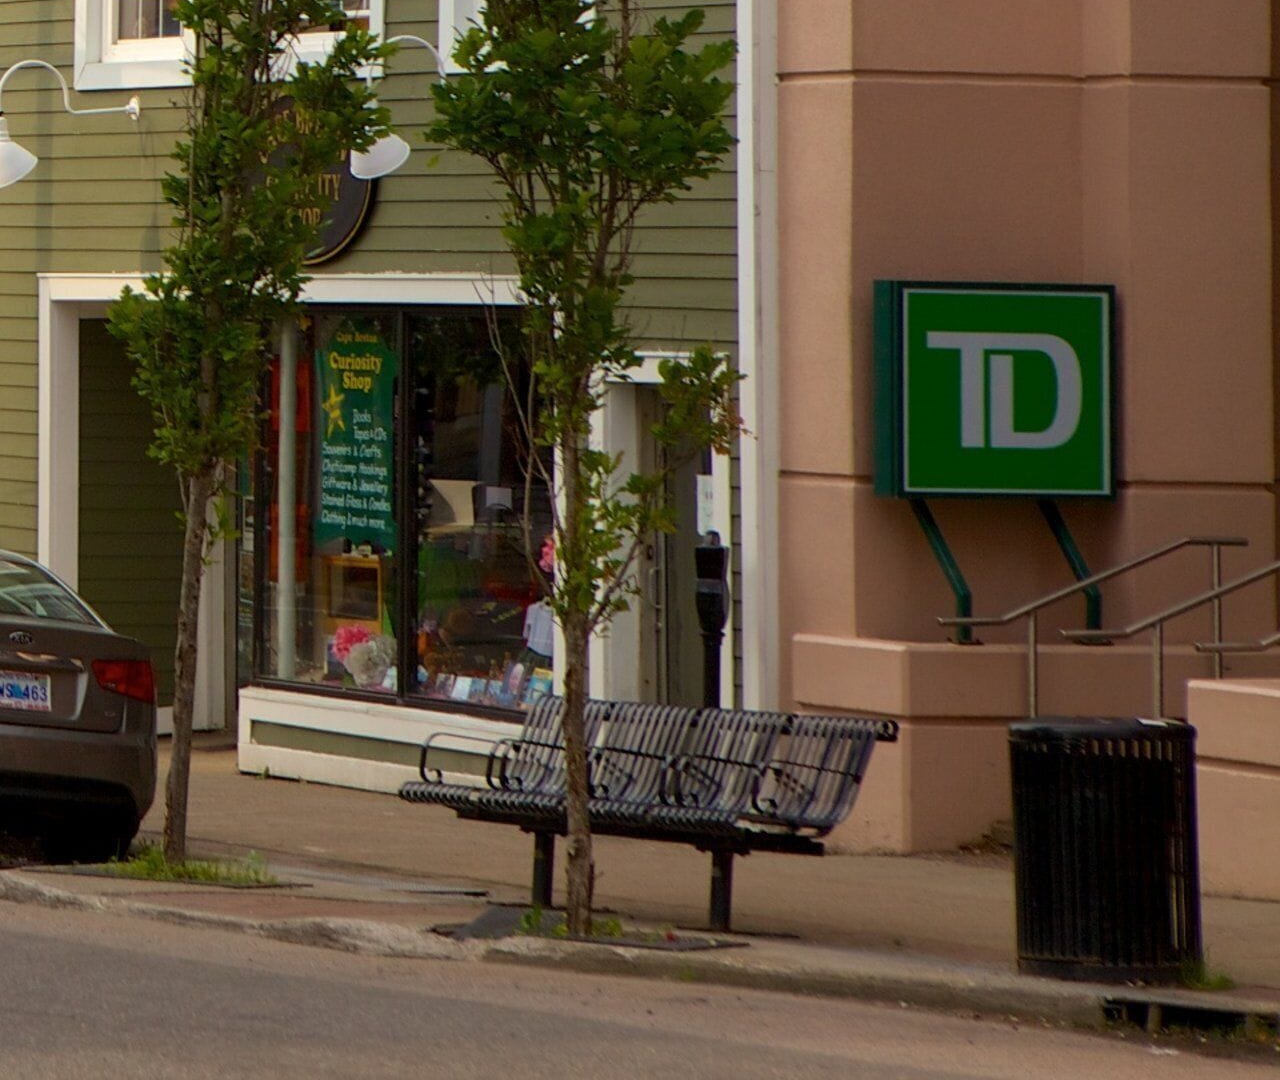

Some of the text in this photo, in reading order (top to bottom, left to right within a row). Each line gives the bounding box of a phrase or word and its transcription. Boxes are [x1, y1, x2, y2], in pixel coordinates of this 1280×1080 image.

[329, 351, 383, 374] Curiosity
[343, 371, 372, 393] Shop
[926, 331, 1083, 449] TD
[360, 444, 381, 458] Crafts
[23, 685, 48, 702] 463
